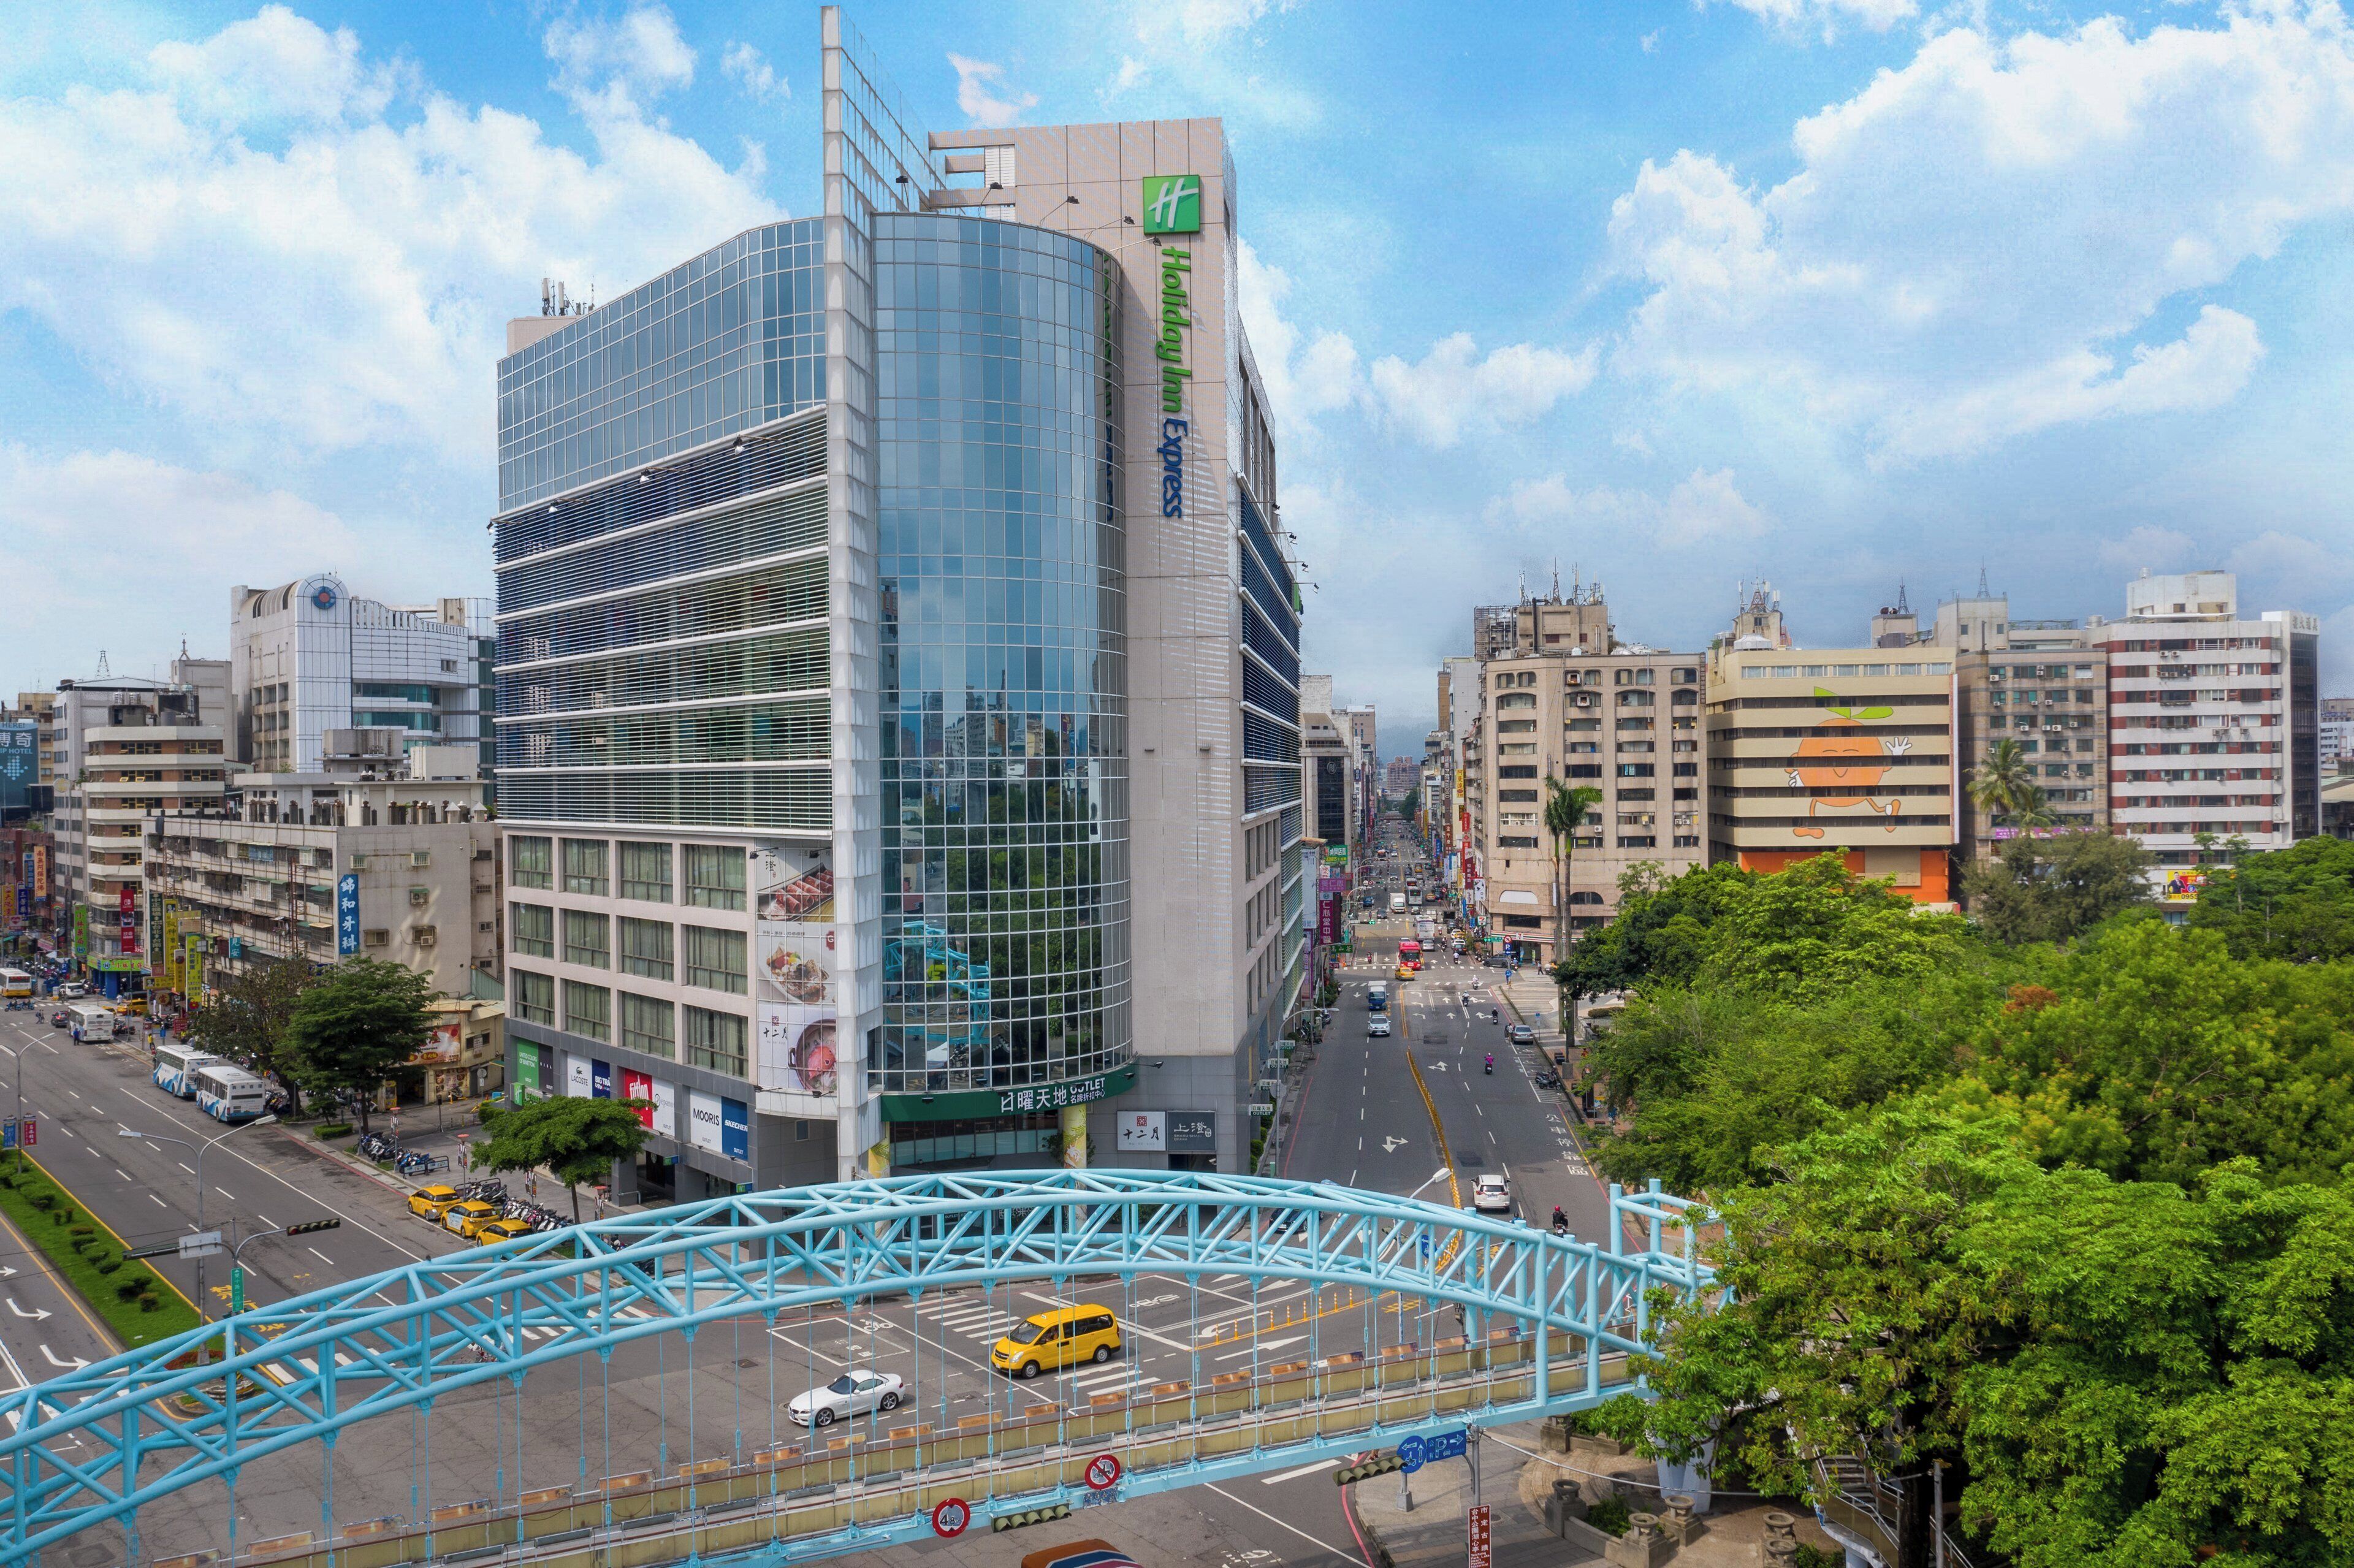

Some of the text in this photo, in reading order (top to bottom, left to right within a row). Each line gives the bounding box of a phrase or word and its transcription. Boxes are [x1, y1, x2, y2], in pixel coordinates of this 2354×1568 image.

[1156, 246, 1191, 413] Holiday Inn
[1157, 417, 1188, 519] Express
[340, 877, 357, 951] 錦和牙科
[1322, 900, 1331, 944] 仁心堂中醫
[230, 938, 238, 957] 見安
[571, 1075, 588, 1086] LACOSTE
[1001, 1085, 1067, 1113] 日曜天地
[1070, 1090, 1105, 1104] 名牌折扣中心
[693, 1108, 720, 1126] MOORIS
[1174, 1122, 1207, 1133] 上澄
[1122, 1125, 1159, 1141] 十二月
[1545, 1114, 1589, 1176] 公車停靠區
[1435, 1437, 1447, 1458] P
